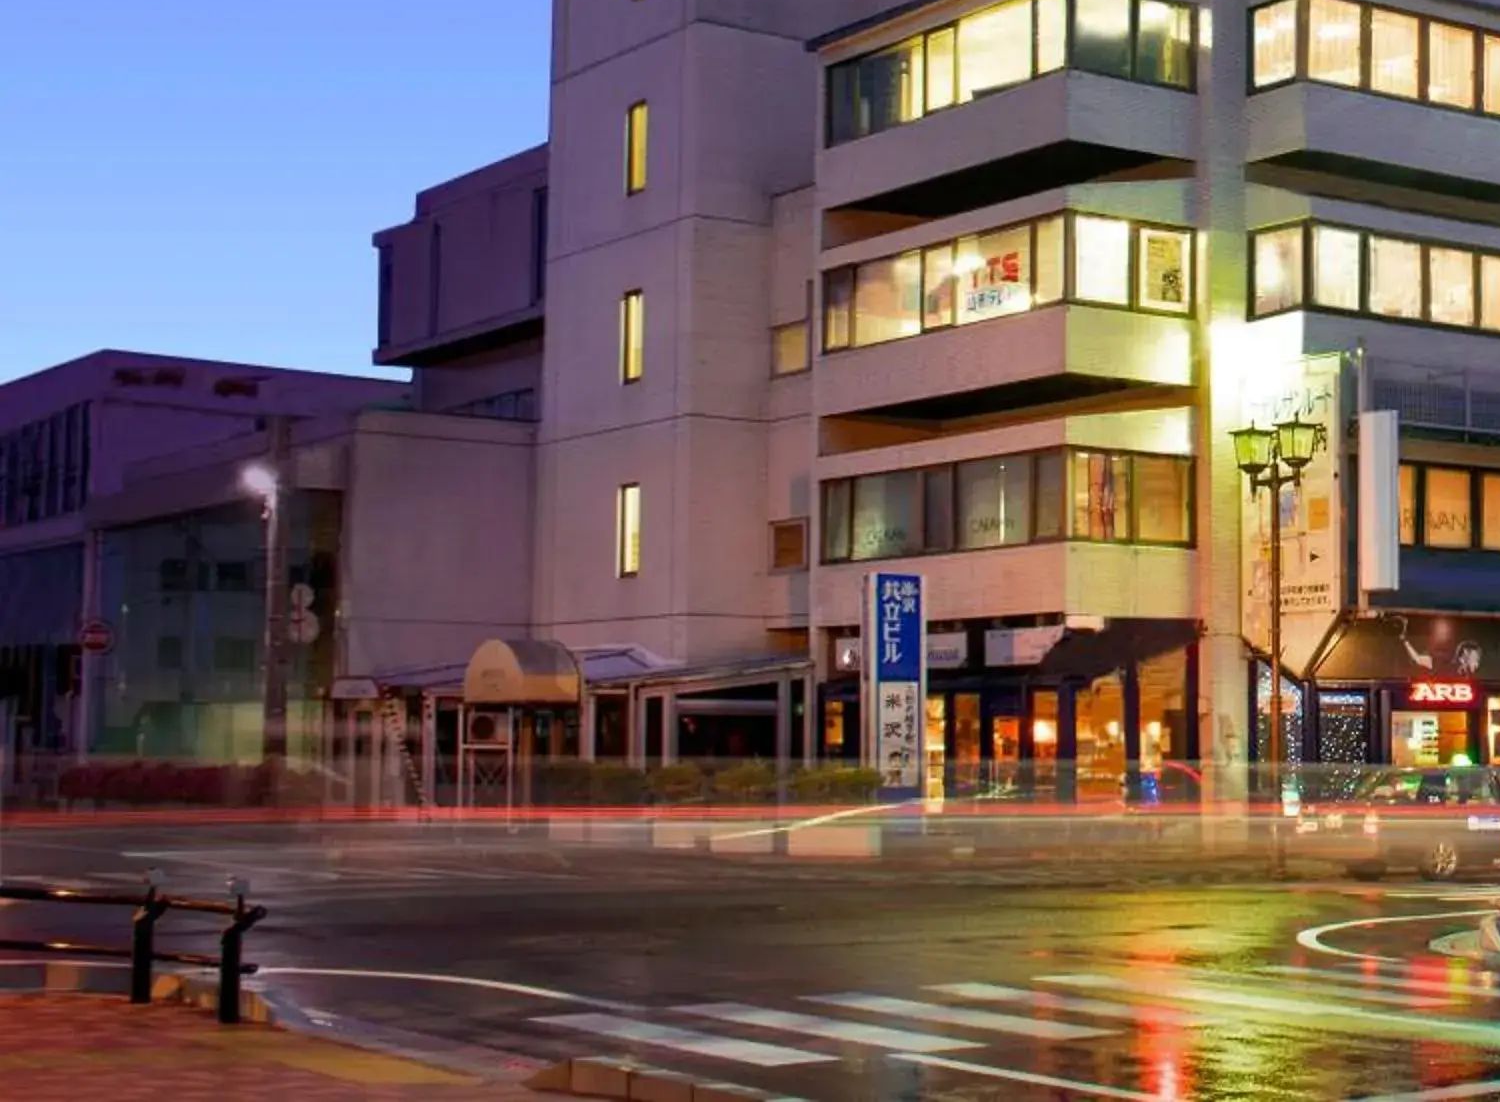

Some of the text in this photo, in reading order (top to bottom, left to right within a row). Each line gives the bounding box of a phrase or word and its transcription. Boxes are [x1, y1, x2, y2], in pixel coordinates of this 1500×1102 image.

[881, 580, 902, 664] 共立ビル
[1410, 682, 1474, 702] ARB
